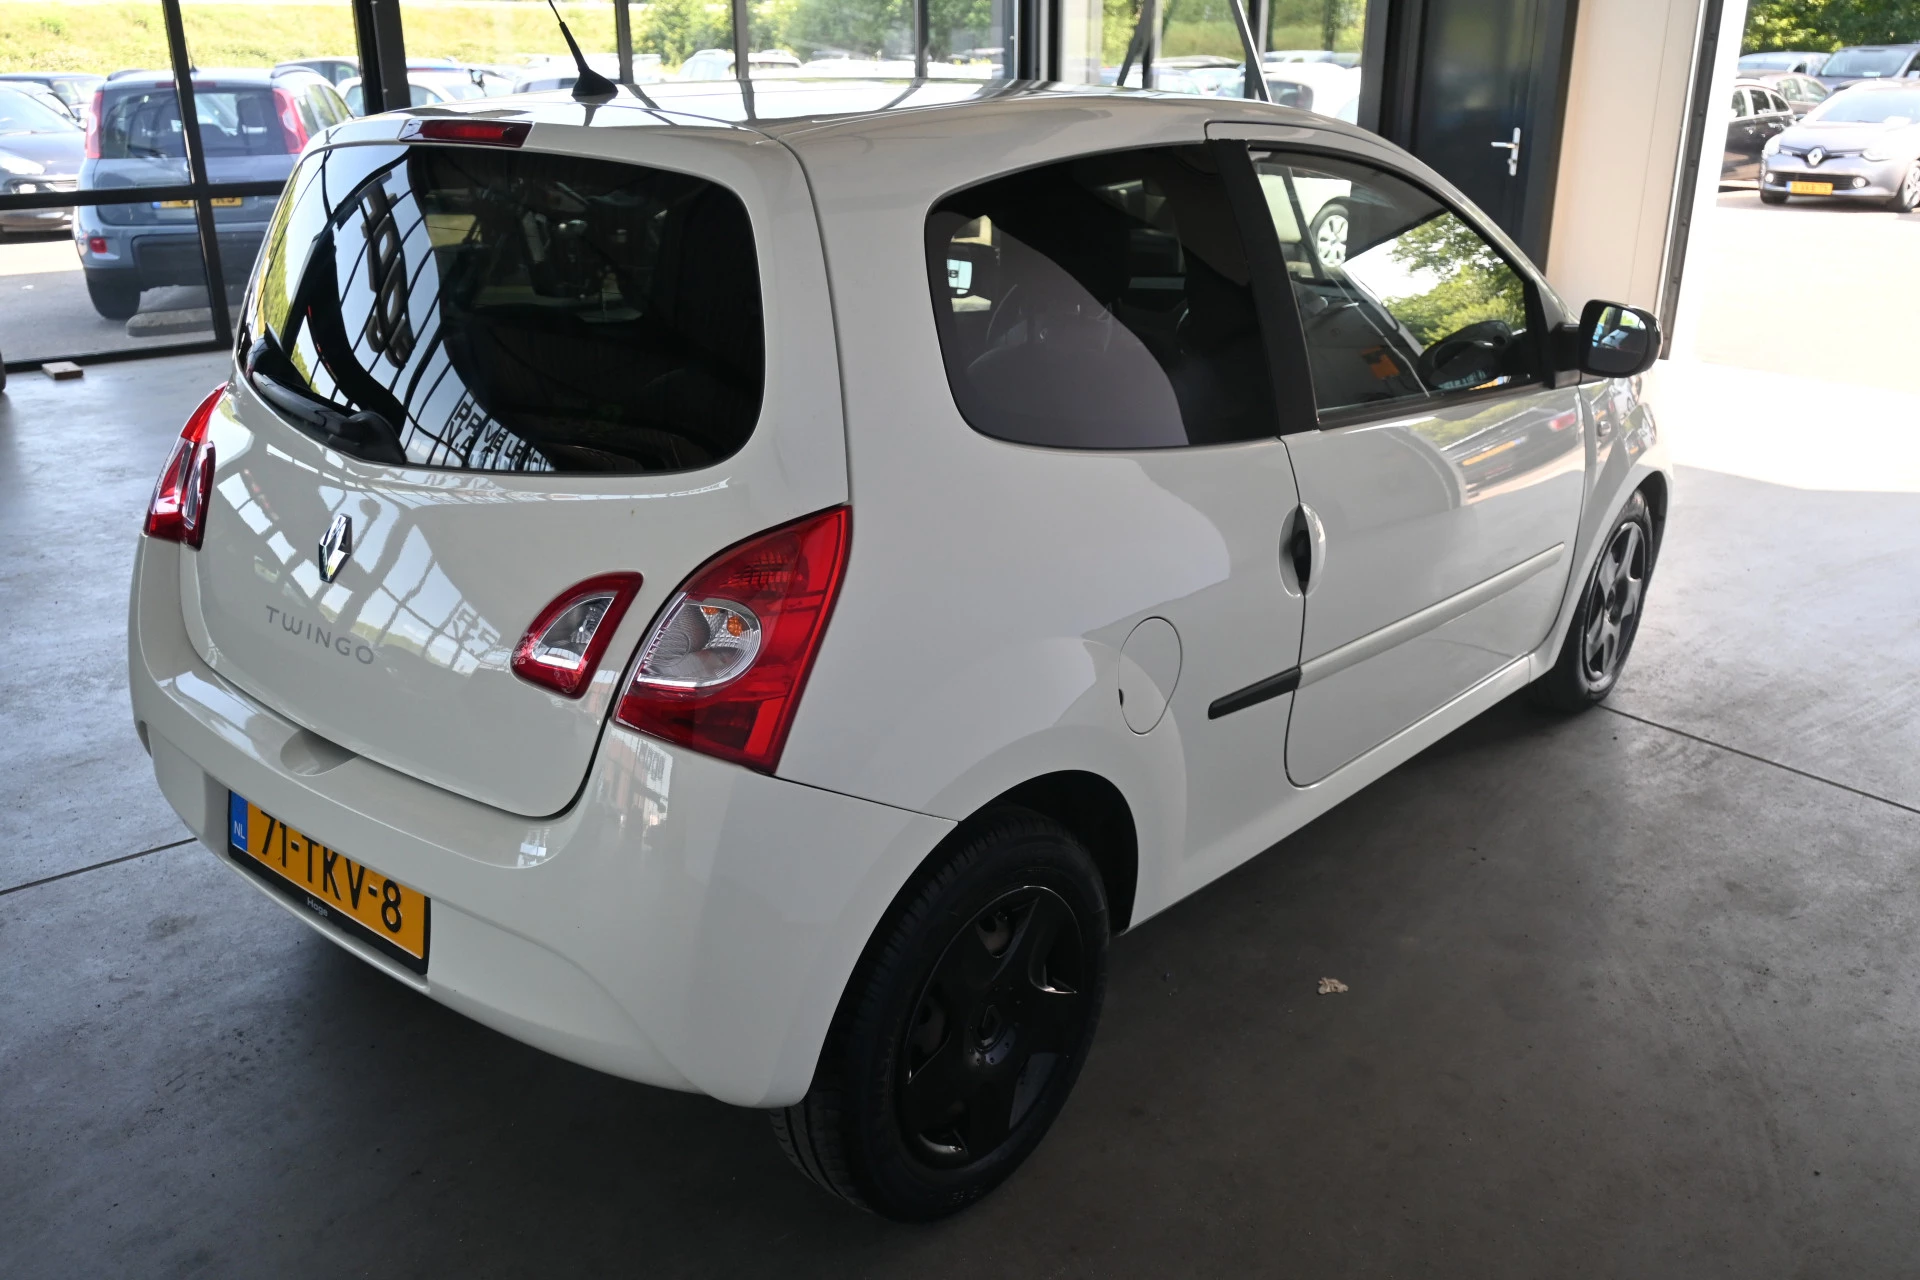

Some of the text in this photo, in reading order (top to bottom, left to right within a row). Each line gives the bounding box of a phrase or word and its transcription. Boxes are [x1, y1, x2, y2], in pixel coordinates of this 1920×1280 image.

[266, 605, 375, 665] TWINGO
[234, 821, 246, 840] NL
[261, 810, 403, 934] 71-TKV-8
[306, 897, 328, 917] Hoge
